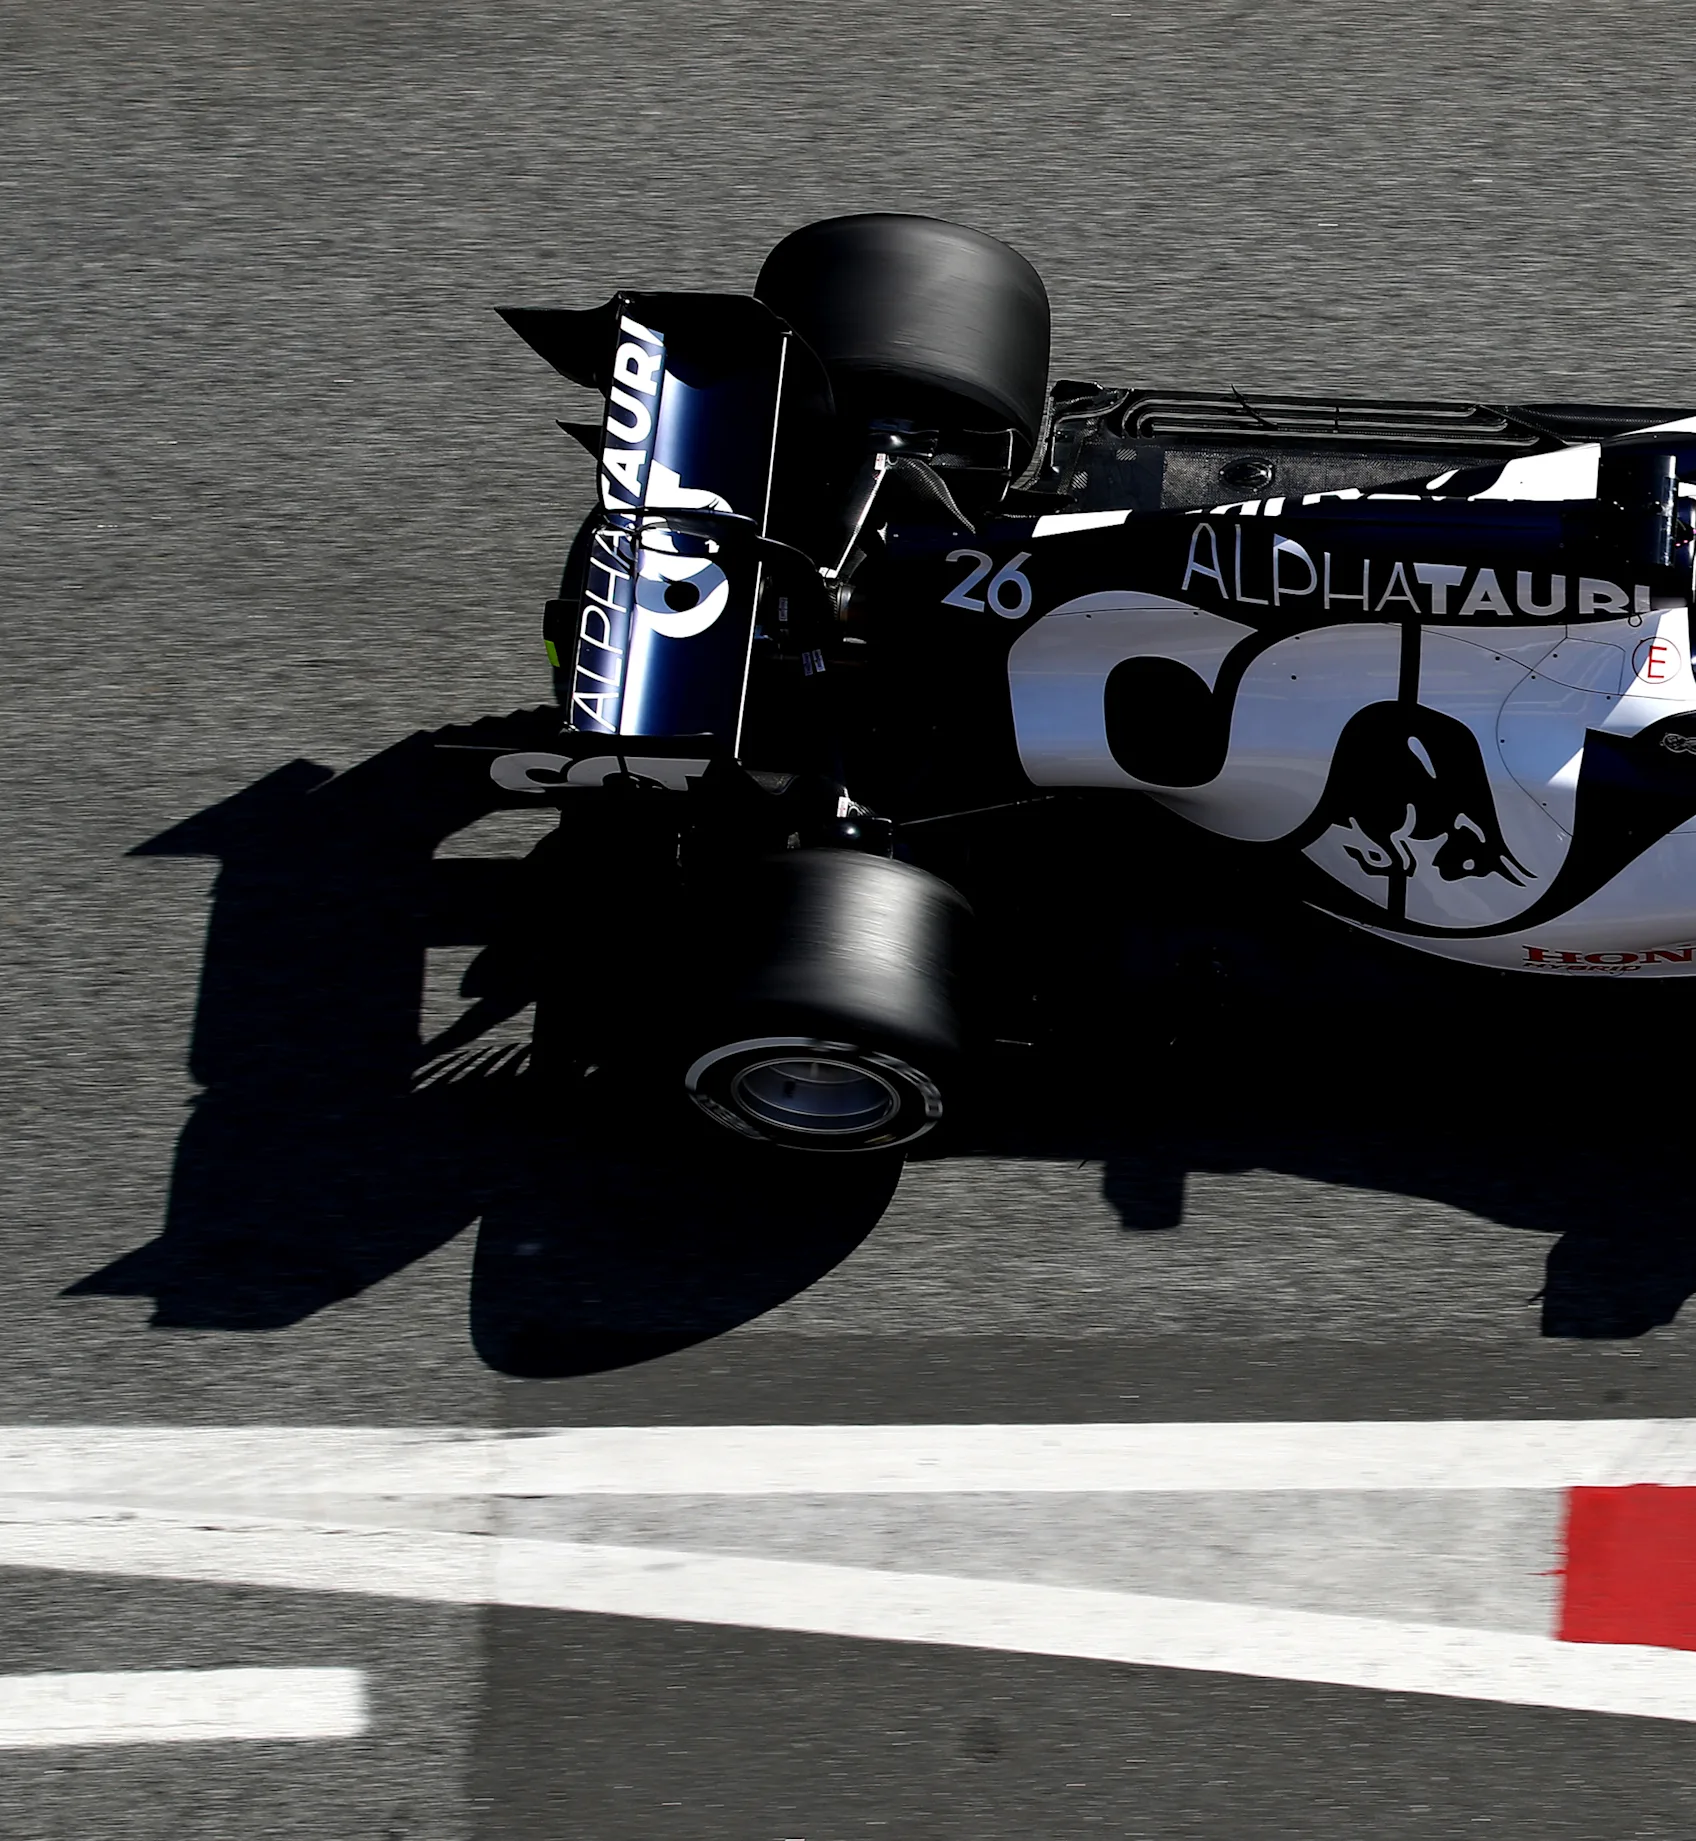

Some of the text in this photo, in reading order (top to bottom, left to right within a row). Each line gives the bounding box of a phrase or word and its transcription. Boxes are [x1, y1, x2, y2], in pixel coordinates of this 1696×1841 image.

[941, 548, 1033, 620] 26
[1647, 645, 1668, 679] E
[1522, 963, 1642, 972] HYBRID
